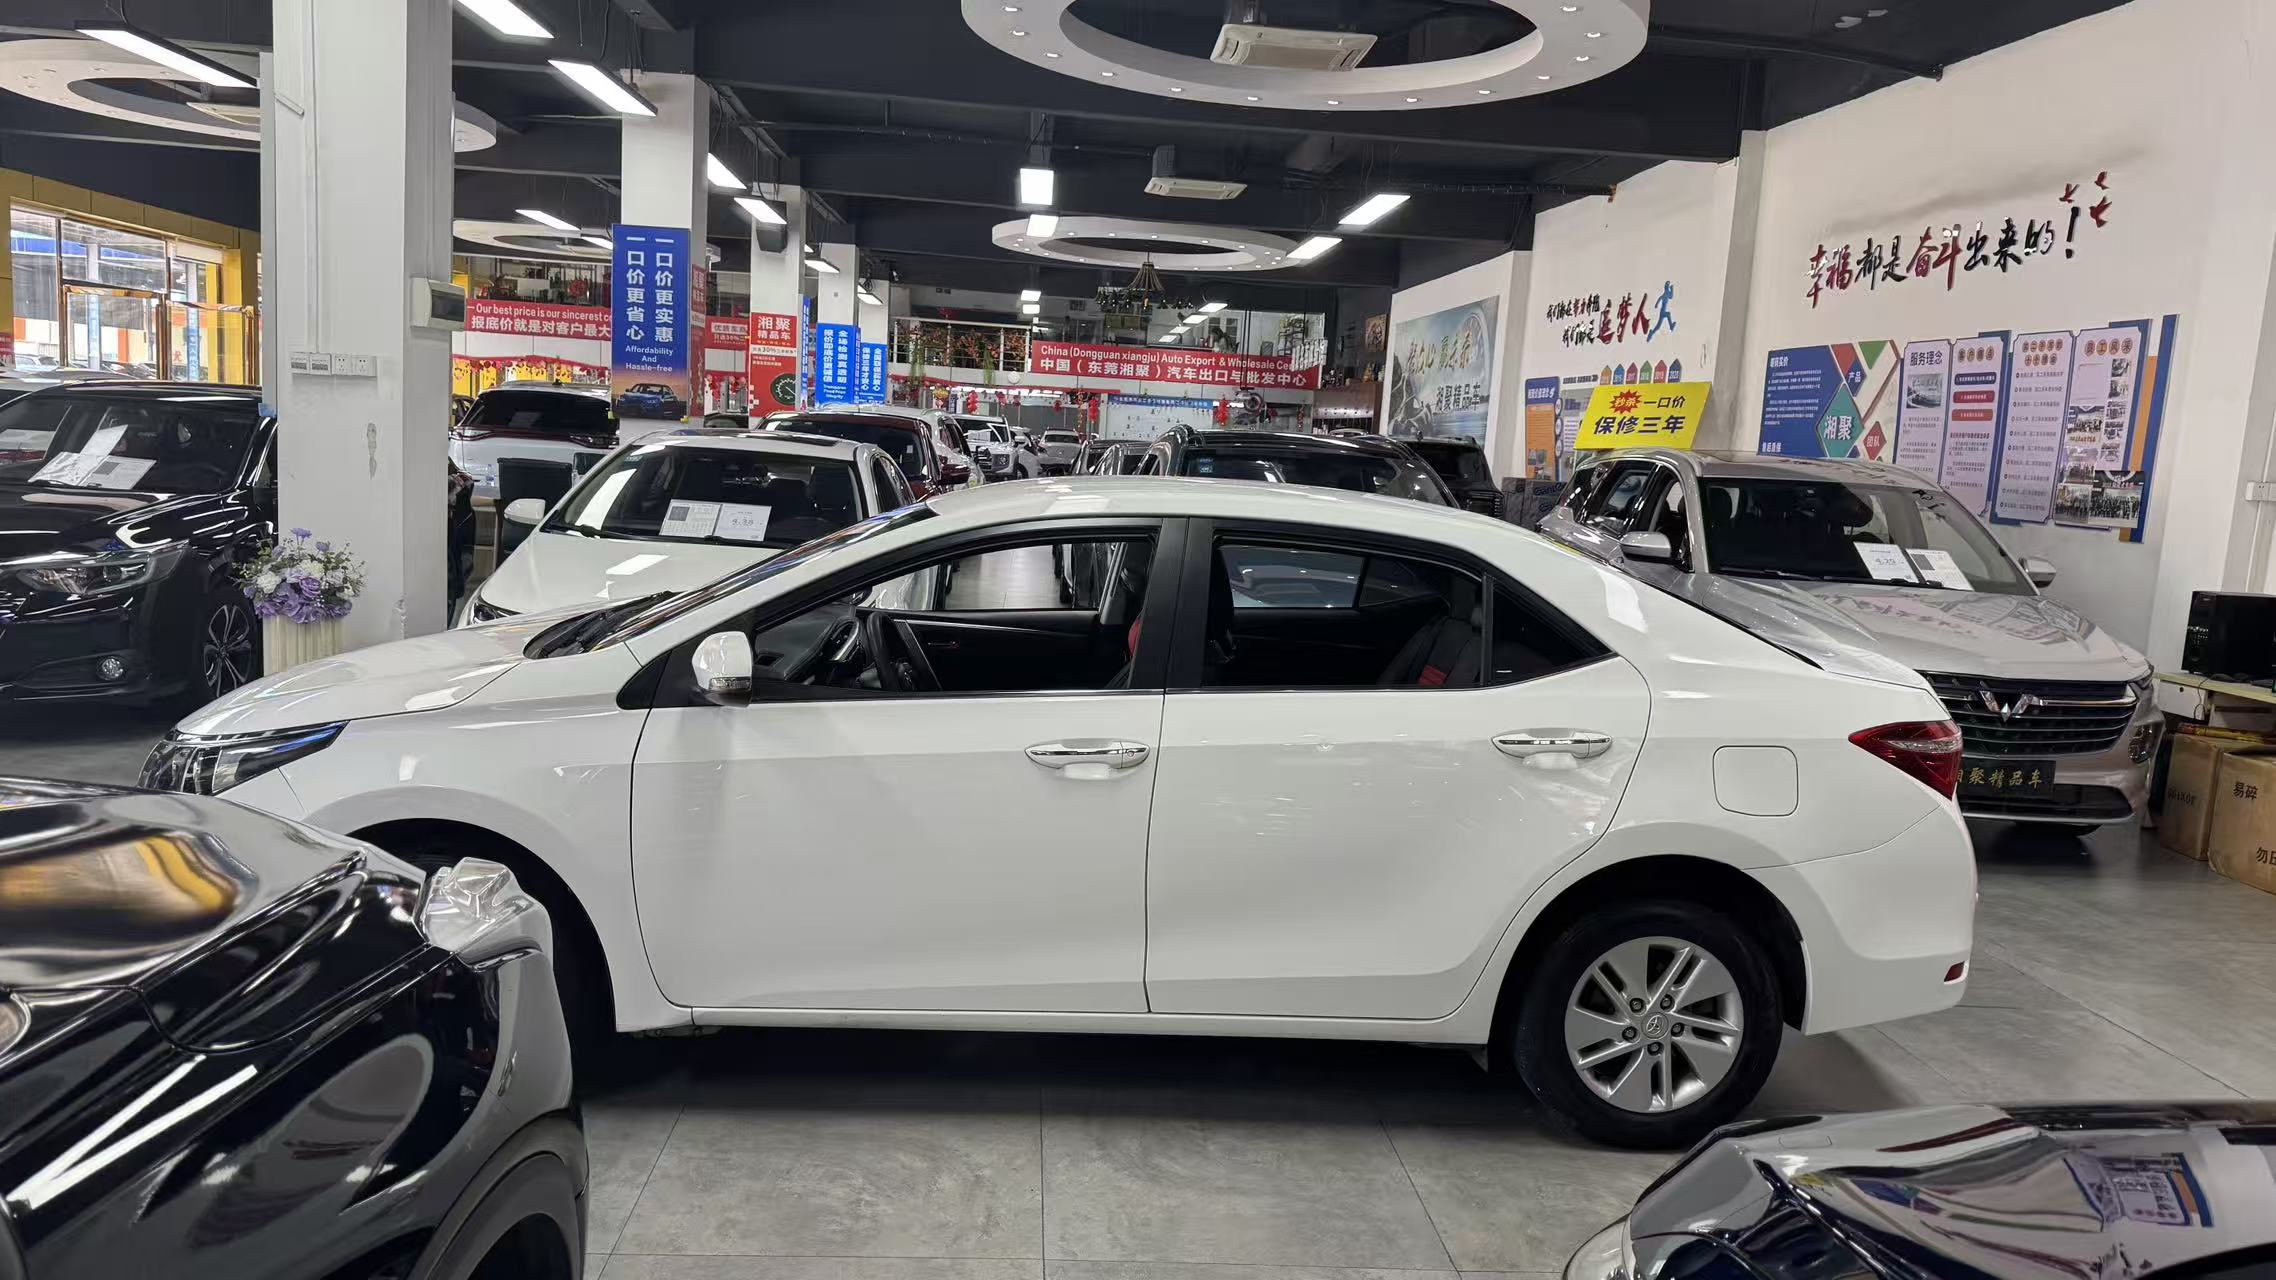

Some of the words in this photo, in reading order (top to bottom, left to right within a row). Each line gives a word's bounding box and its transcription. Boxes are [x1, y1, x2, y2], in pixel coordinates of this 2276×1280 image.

[626, 236, 646, 341] 一口价更省心
[655, 238, 674, 342] 一口价更实惠
[476, 303, 492, 314] Our
[492, 303, 513, 315] best
[513, 305, 536, 318] price
[537, 307, 545, 317] is
[546, 309, 560, 318] our
[561, 309, 602, 321] sincerest
[471, 315, 611, 338] 报底价就是对客户最大
[757, 316, 791, 331] 湘聚
[757, 330, 791, 341] 精品车
[625, 345, 674, 356] Affordability
[641, 355, 657, 363] And
[1041, 345, 1068, 356] China
[1069, 346, 1120, 361] (Dongguan
[1121, 350, 1161, 364] xiangju)
[1161, 353, 1183, 364] Auto
[1184, 354, 1216, 367] Export
[1219, 356, 1226, 366] &
[1227, 357, 1275, 369] Wholesale
[1910, 350, 1943, 366] 服务理念
[625, 362, 673, 372] Hassle-free
[1848, 371, 1862, 383] 产品
[1644, 396, 1686, 409] 一口价
[1594, 415, 1686, 435] 保修三年
[1823, 415, 1851, 441] 湘聚
[2233, 781, 2258, 801] 易碎
